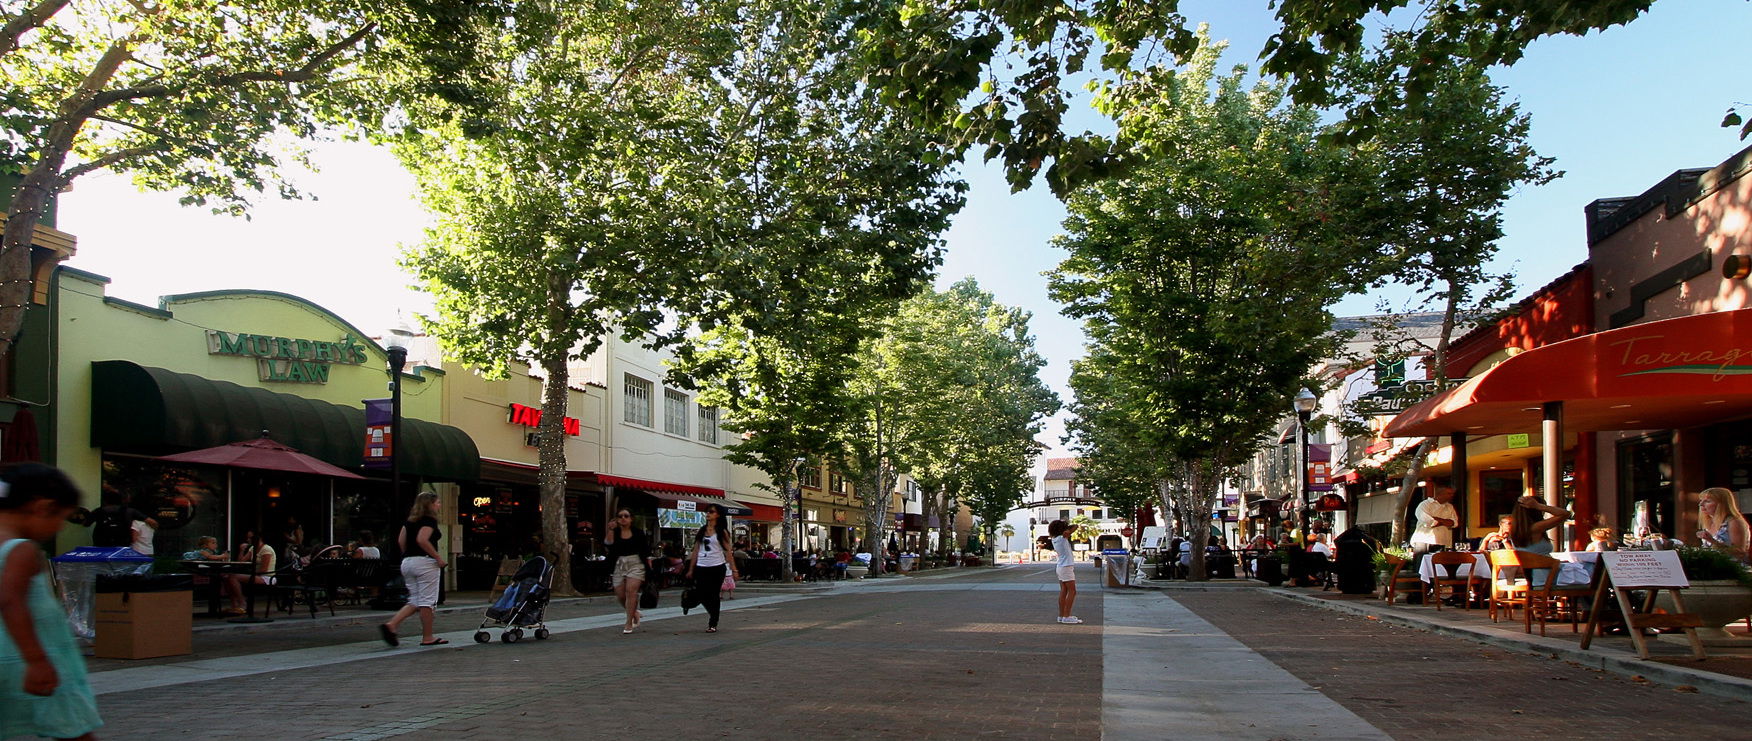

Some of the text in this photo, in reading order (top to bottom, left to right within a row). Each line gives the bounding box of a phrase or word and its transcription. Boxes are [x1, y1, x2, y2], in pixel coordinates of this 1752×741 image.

[212, 331, 368, 364] MURPHY'S
[1609, 335, 1752, 382] Tarrag
[266, 359, 332, 383] LAW
